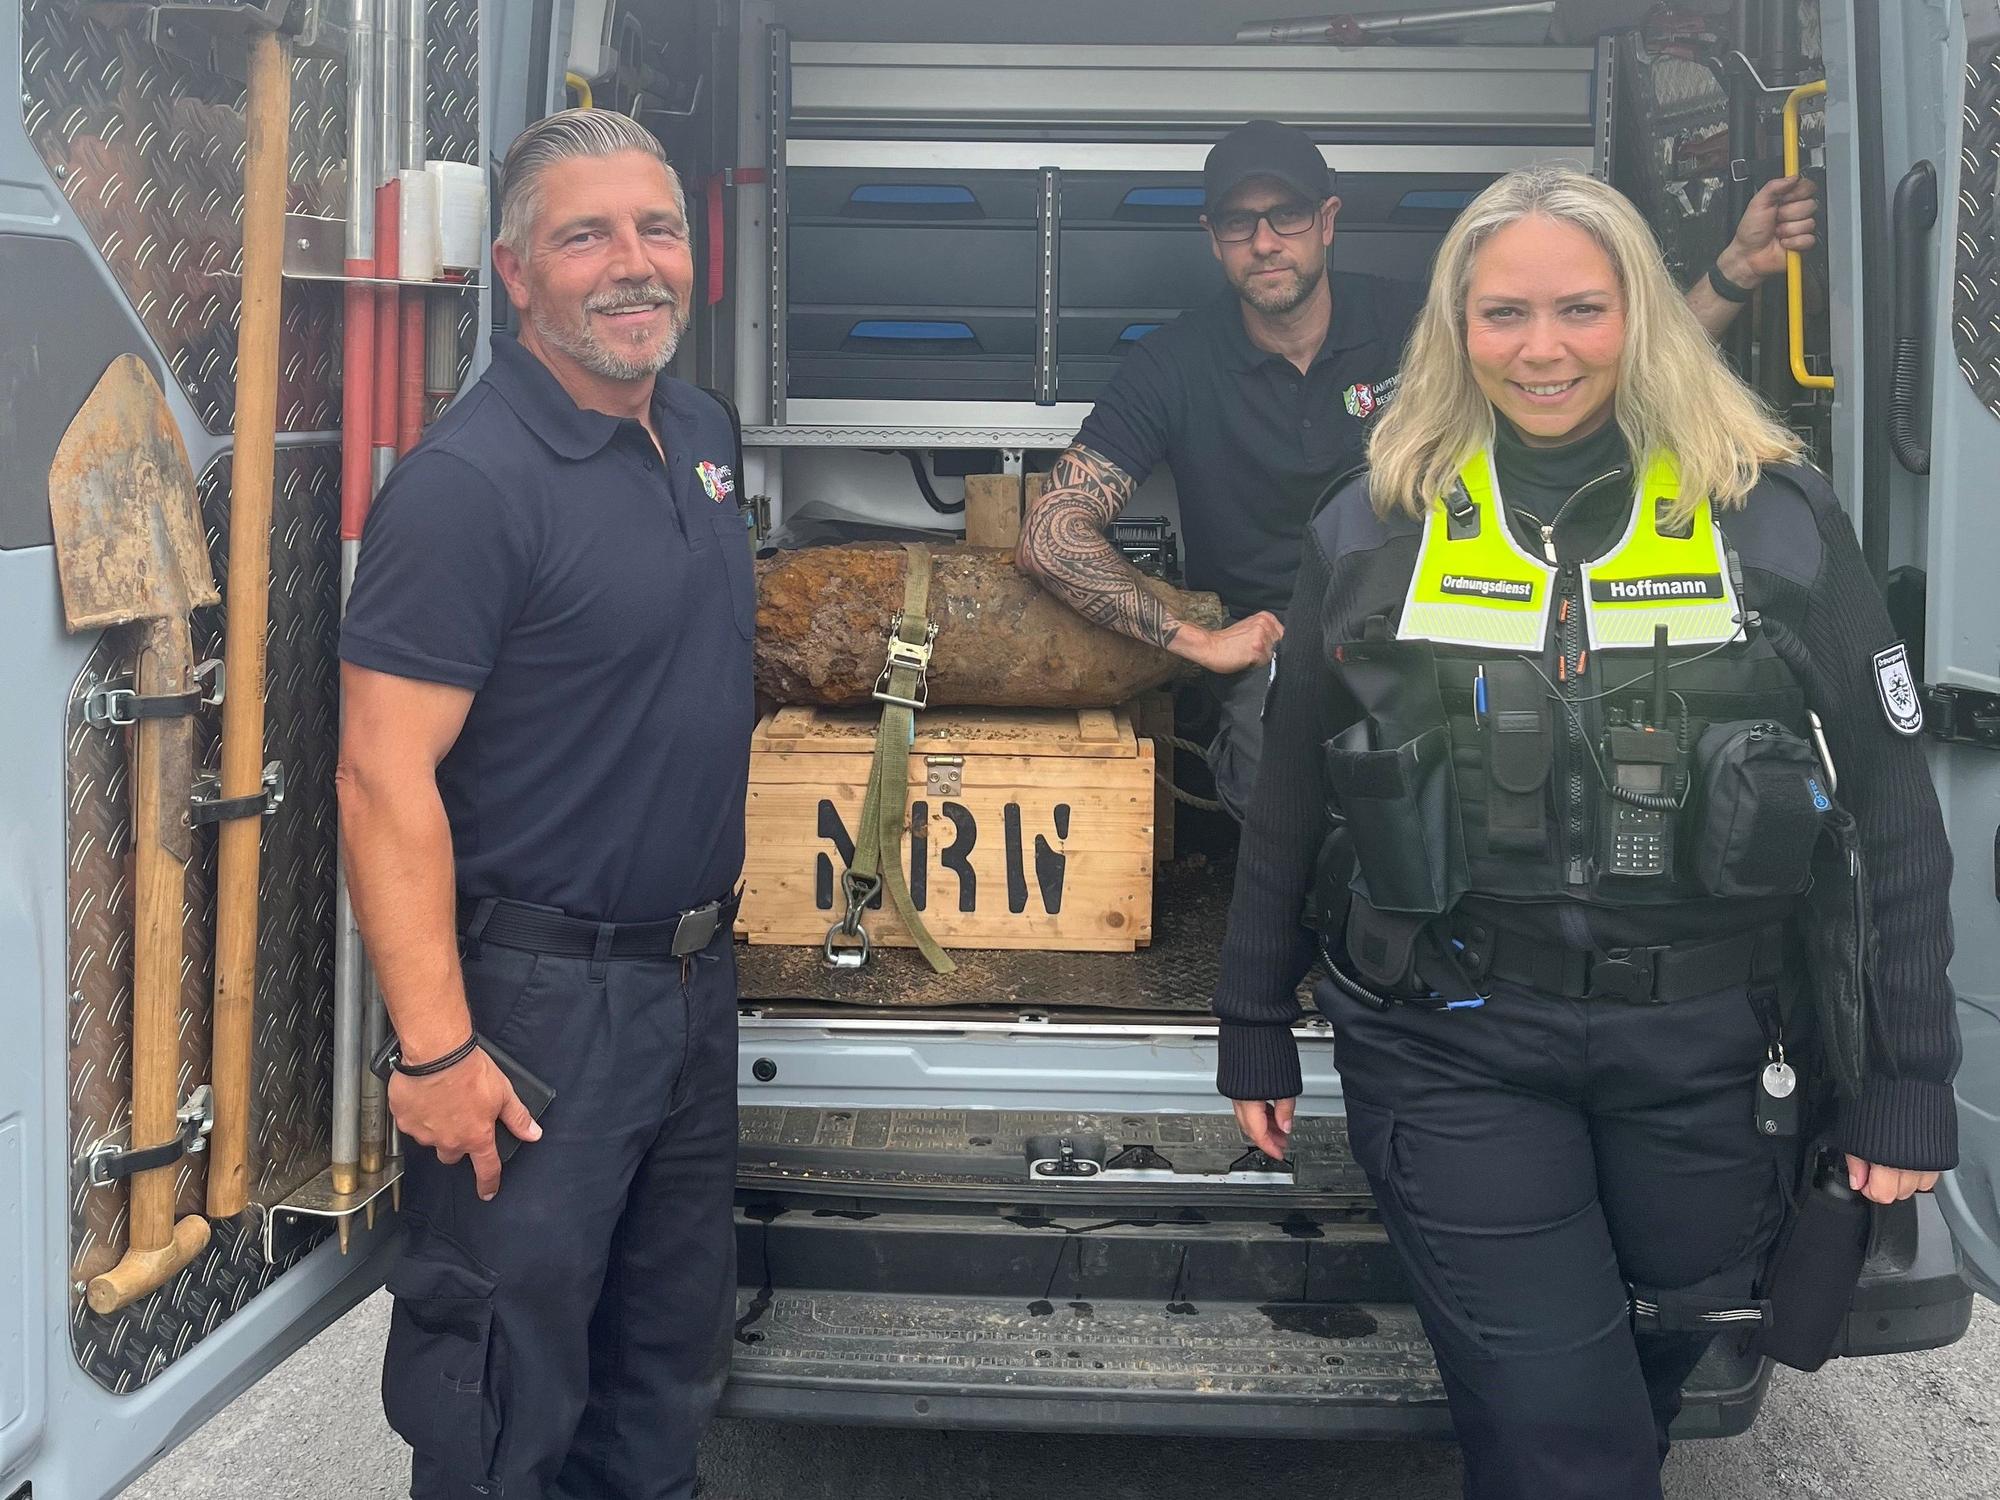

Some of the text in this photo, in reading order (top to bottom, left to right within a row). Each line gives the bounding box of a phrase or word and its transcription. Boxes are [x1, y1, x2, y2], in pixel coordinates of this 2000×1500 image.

[1442, 575, 1531, 595] Ordnungsdienst
[1610, 579, 1707, 598] Hoffmann
[816, 799, 1071, 914] NRW
